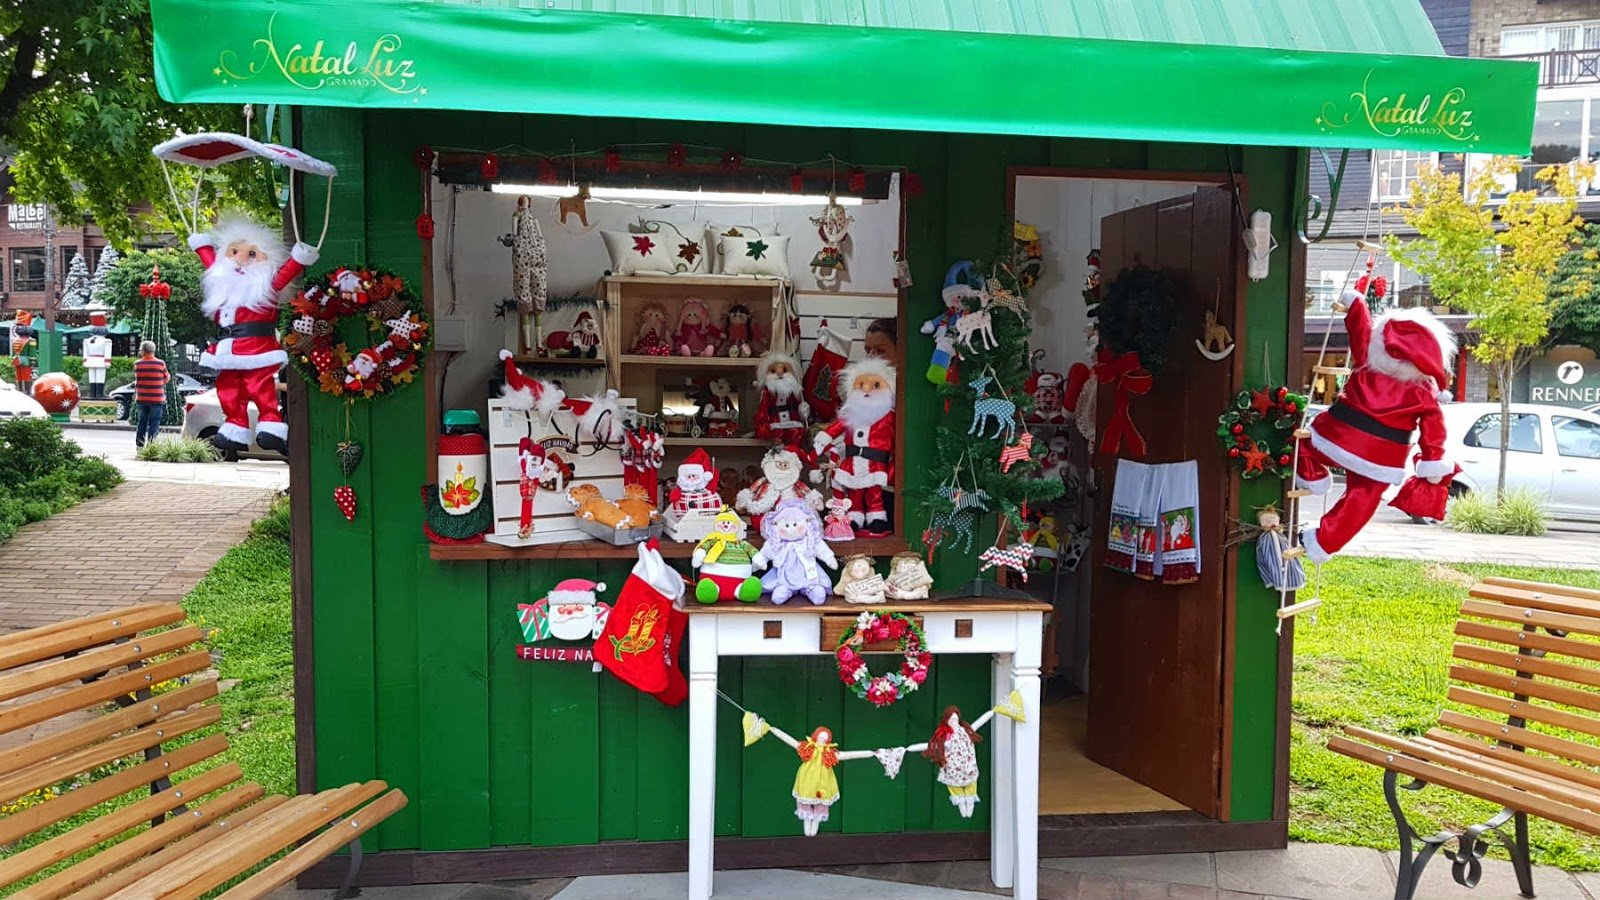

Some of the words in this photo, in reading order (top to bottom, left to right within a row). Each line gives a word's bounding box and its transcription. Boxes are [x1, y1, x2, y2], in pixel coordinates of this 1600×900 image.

[246, 22, 357, 90] Natal
[361, 34, 418, 92] Luz
[1341, 79, 1428, 137] Natal
[1432, 87, 1474, 139] Luz
[523, 647, 567, 661] FELIZ
[574, 649, 594, 662] NA
